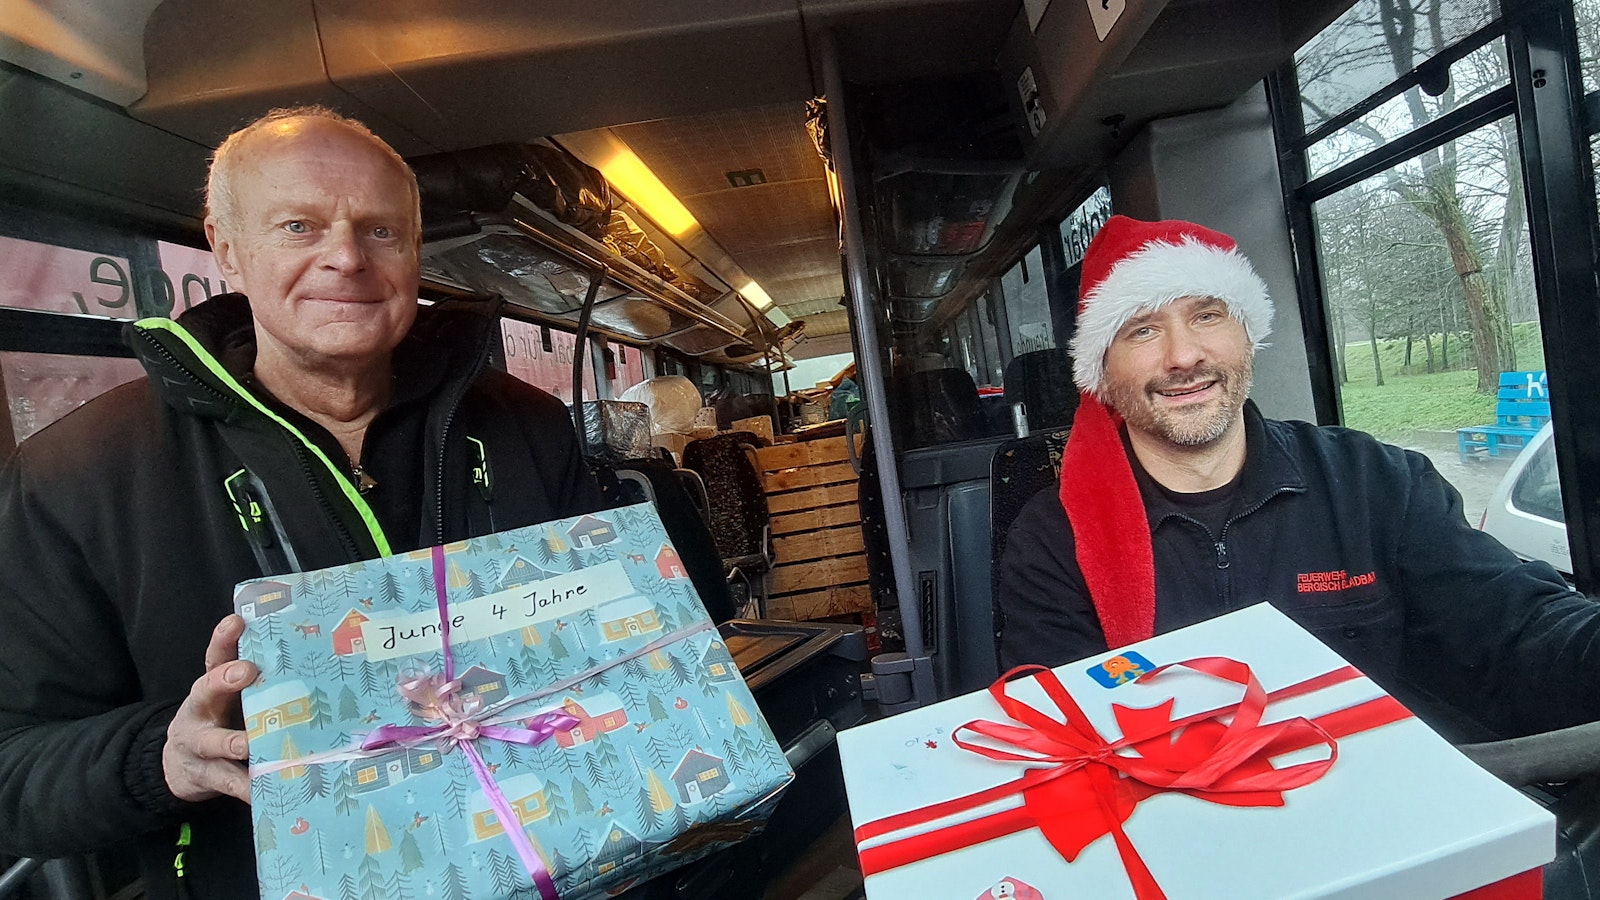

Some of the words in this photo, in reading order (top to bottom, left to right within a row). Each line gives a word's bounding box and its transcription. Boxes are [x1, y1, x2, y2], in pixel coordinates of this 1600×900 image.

[1297, 580, 1341, 592] BERGISCH
[379, 613, 465, 650] June
[491, 603, 507, 620] 4
